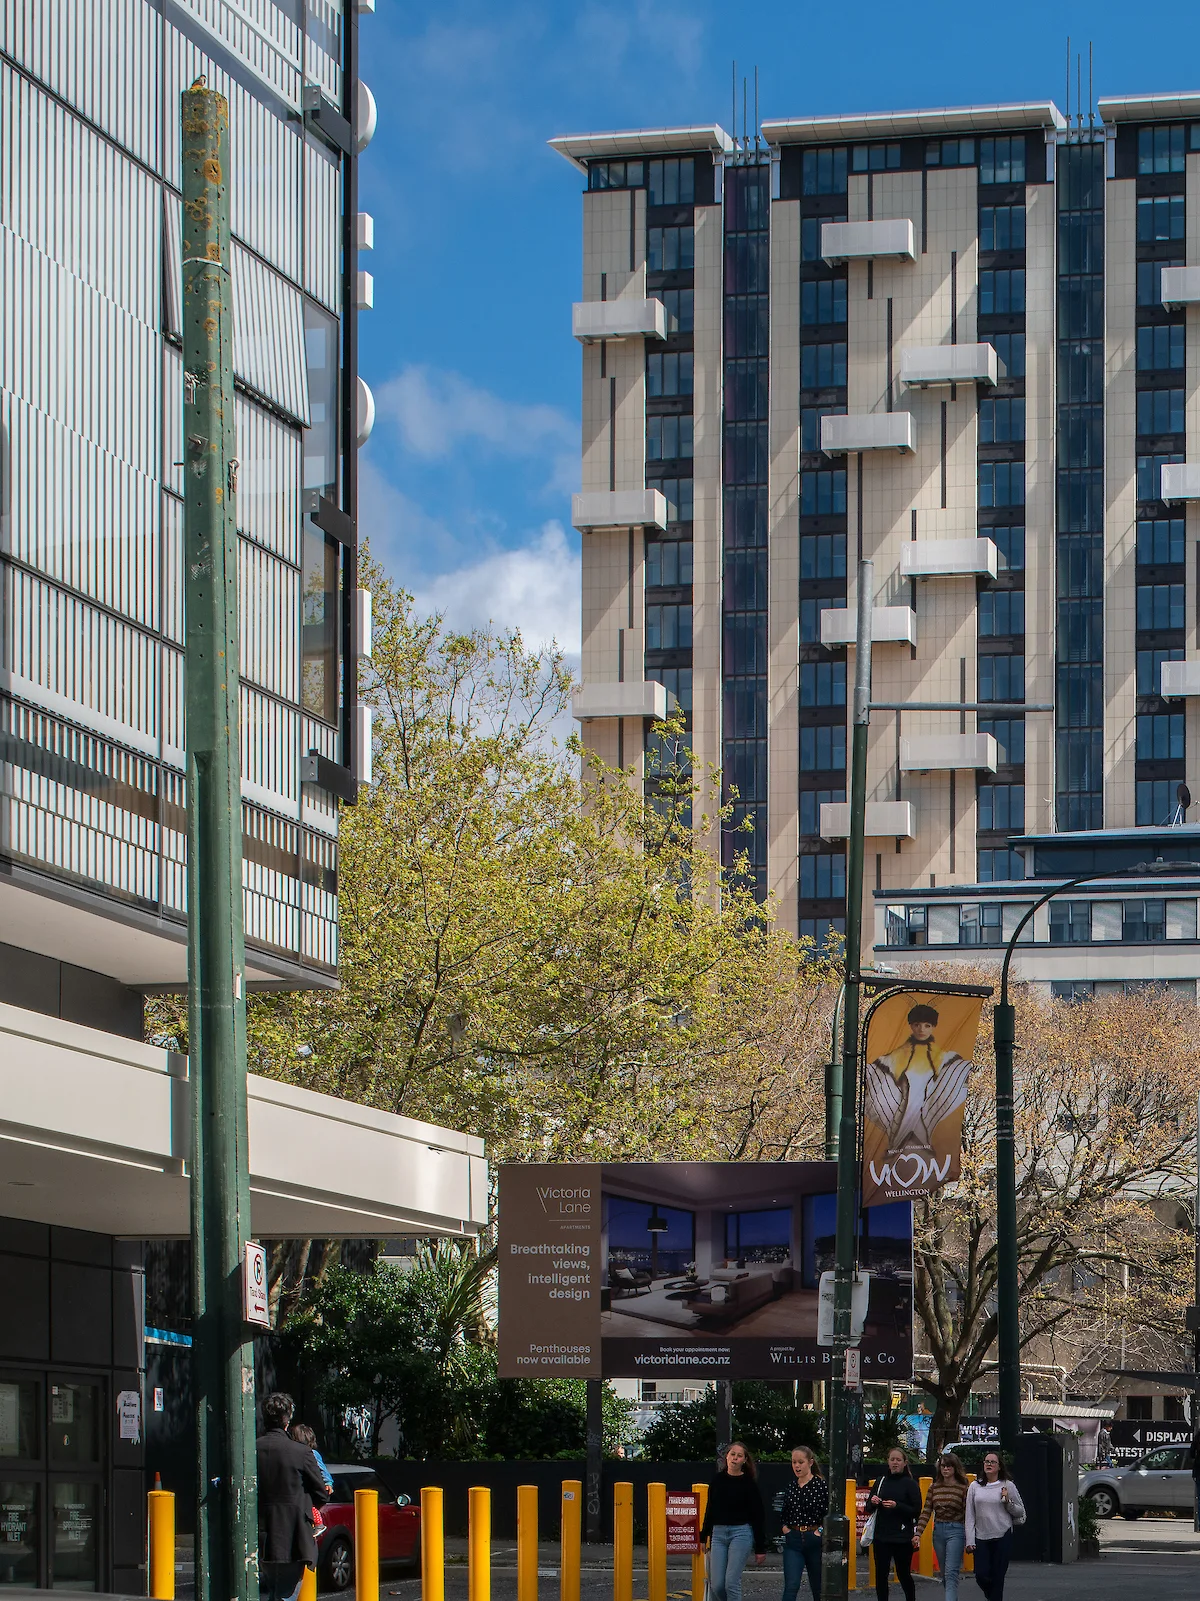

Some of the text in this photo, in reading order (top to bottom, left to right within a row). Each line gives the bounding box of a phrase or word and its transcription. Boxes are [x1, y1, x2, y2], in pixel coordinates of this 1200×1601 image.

[869, 1153, 951, 1188] WOW
[540, 1187, 591, 1199] Victoria
[885, 1188, 930, 1198] WELLINGTON
[559, 1201, 591, 1213] Lane
[510, 1243, 590, 1256] Breathtaking
[552, 1258, 590, 1270] views,
[528, 1273, 590, 1286] intelligent
[548, 1288, 590, 1301] design
[529, 1343, 591, 1354] Penthouses
[516, 1354, 591, 1365] now available
[634, 1354, 731, 1365] victorialane.co.nz
[863, 1355, 872, 1364] &
[961, 1424, 998, 1436] Willis St
[1146, 1431, 1189, 1443] DISPLAY
[1109, 1446, 1144, 1458] LATEST
[8, 1512, 20, 1522] FIRE
[1, 1522, 27, 1532] HYDRANT
[7, 1531, 21, 1542] INLET
